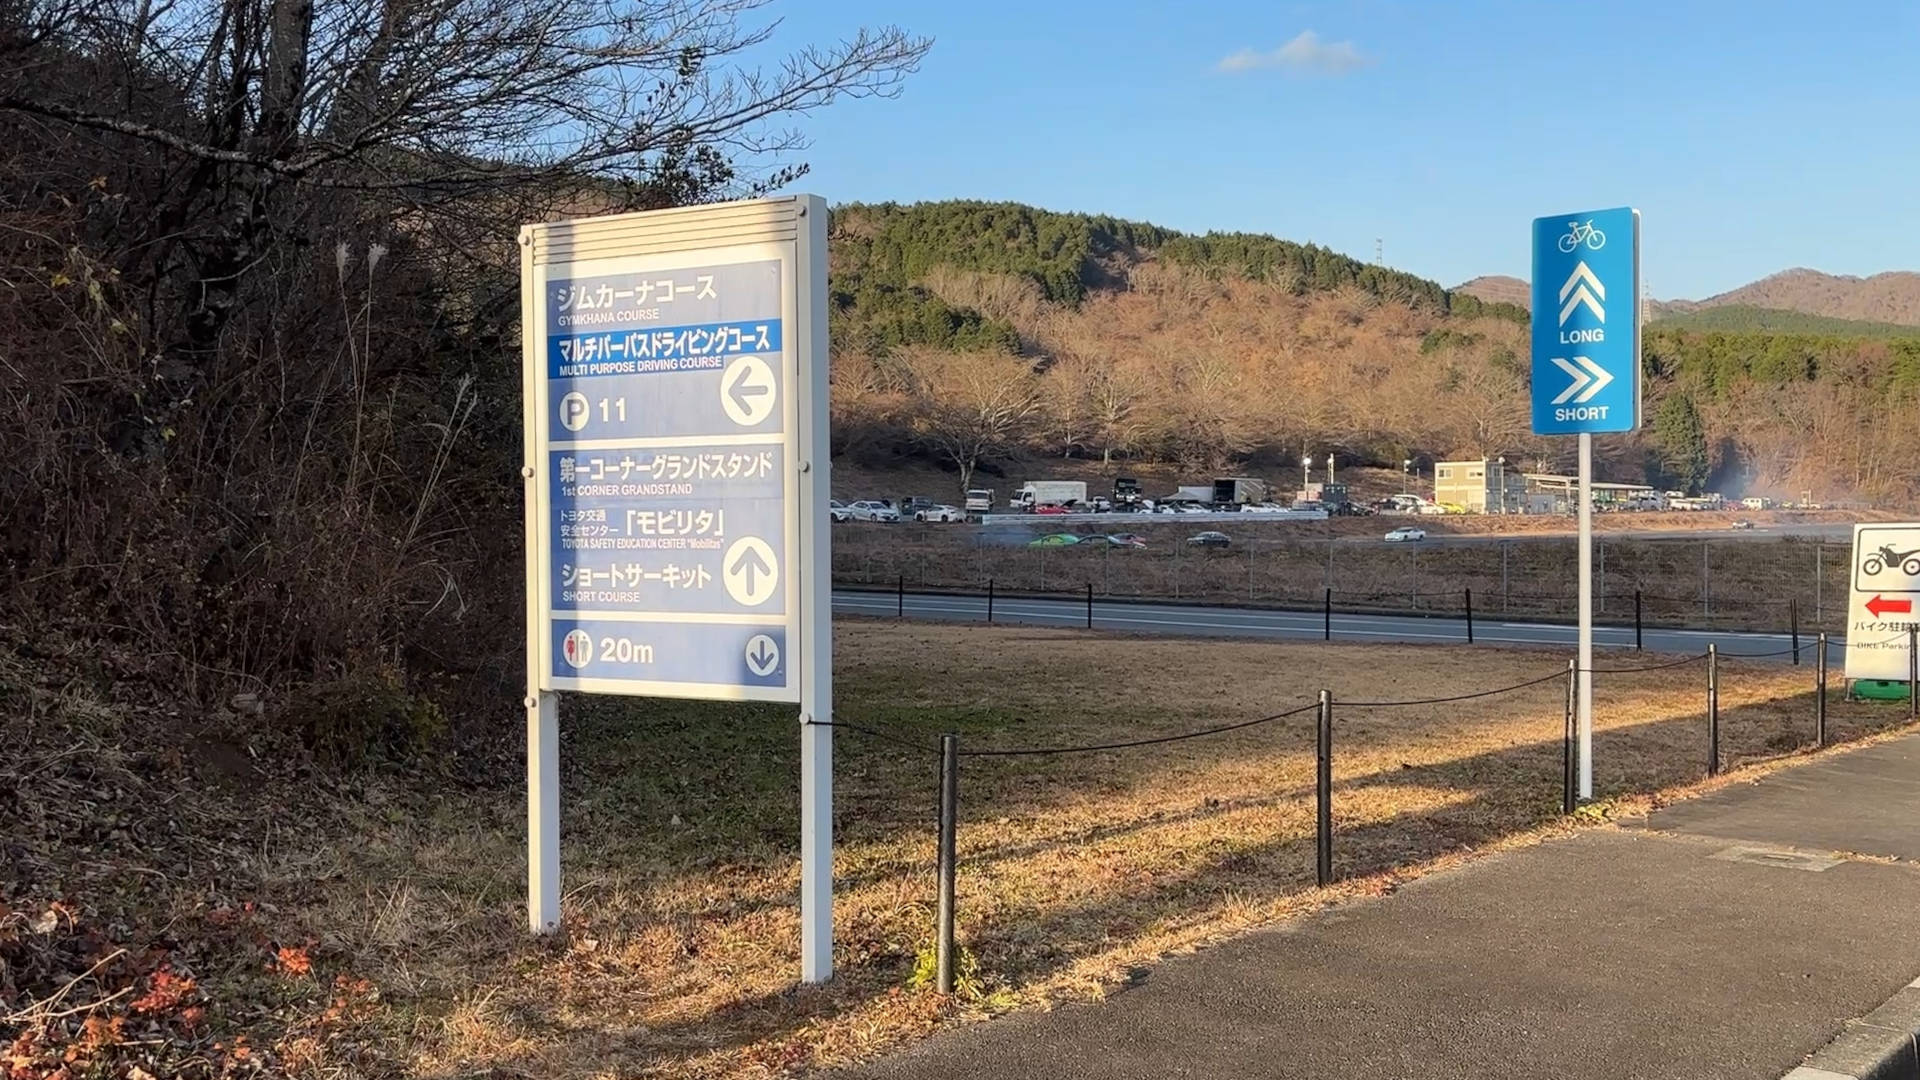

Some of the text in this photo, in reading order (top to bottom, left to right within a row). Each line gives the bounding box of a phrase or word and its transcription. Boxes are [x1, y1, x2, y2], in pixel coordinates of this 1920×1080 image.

[558, 275, 717, 312] ジムカーナコース
[558, 308, 660, 327] GYMKHANA COURSE
[1560, 328, 1604, 344] LONG
[559, 355, 722, 376] MULTI PURPOSE DRIVING COURSE
[567, 397, 625, 425] P 11
[1555, 406, 1609, 421] SHORT
[559, 452, 773, 482] 第一コーナーグランドスタンド
[561, 483, 693, 497] 1st CORNER GRANDSTAND
[560, 509, 606, 522] トヨタ交通
[560, 525, 619, 537] 安全センター
[562, 538, 589, 549] TOYOTA
[590, 538, 616, 549] SAFETY
[616, 538, 657, 549] EDUCATION
[657, 537, 687, 549] CENTER
[561, 563, 712, 589] ショートサーキット
[562, 591, 640, 602] SHORT COURSE
[599, 637, 653, 664] 20m
